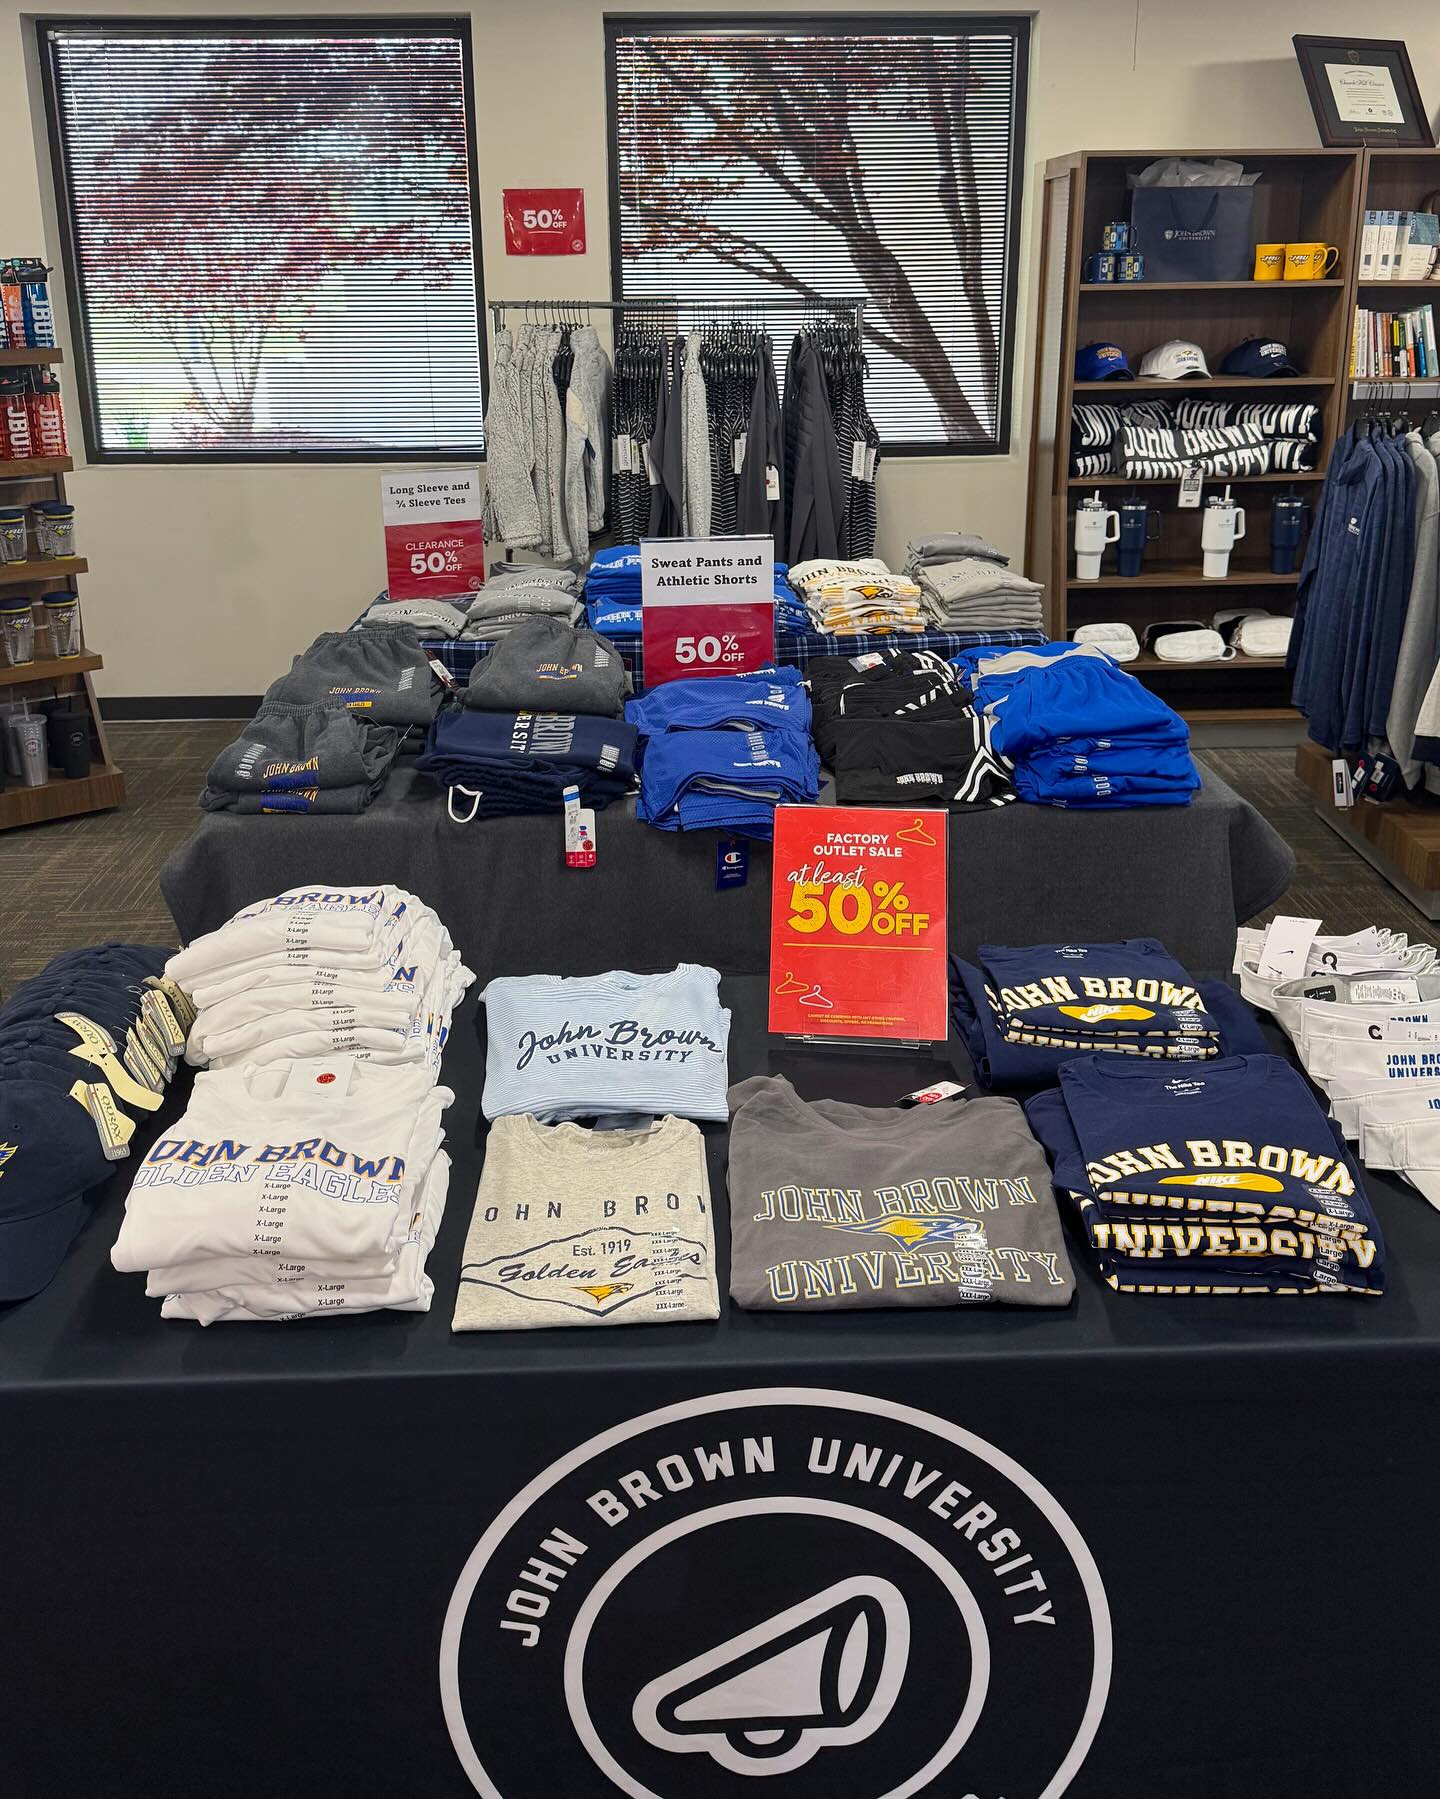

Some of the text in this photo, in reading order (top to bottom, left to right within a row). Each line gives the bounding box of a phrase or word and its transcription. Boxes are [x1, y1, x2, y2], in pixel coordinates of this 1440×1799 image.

[523, 209, 563, 228] 50%
[31, 294, 53, 335] JBU
[389, 482, 470, 496] Long Sleeve and
[409, 498, 440, 508] Sleeve
[444, 497, 466, 505] Tees
[406, 540, 464, 551] CLEARANCE
[410, 550, 462, 574] 50% OFF
[652, 558, 692, 568] Sweat
[696, 556, 733, 568] Pants
[738, 556, 762, 566] and
[656, 574, 758, 586] Athletic Shorts
[675, 635, 744, 664] 50% OFF
[263, 756, 319, 778] JOHN BROWN
[826, 834, 889, 844] FACTORY
[813, 845, 902, 857] OUTLET SALE
[787, 861, 867, 890] at least
[787, 880, 929, 935] 50% OFF
[316, 971, 338, 979] XX-Large
[312, 988, 334, 996] XX-Large
[332, 1018, 355, 1026] XX-Large
[332, 1035, 355, 1043] XX-Large
[516, 1020, 722, 1070] John Brown
[546, 1044, 694, 1064] UNIVERSITY
[1386, 1054, 1416, 1065] JOHN
[1186, 1140, 1357, 1196] BROWN
[1196, 1175, 1240, 1186] NIKE
[753, 1176, 1038, 1223] JOHN BROWN
[259, 1206, 286, 1214] X-Large
[256, 1220, 284, 1228] X-Large
[1330, 1222, 1354, 1230] X-Large
[254, 1234, 282, 1243] X-Large
[572, 1239, 631, 1256] Est. 1919
[1321, 1248, 1342, 1257] Large
[278, 1264, 305, 1272] X-Large
[1317, 1259, 1339, 1270] Large
[498, 1262, 598, 1282] Golden
[766, 1248, 1065, 1302] UNIVERITY
[1314, 1272, 1336, 1283] Large
[318, 1298, 344, 1306] X-Large
[500, 1436, 1056, 1648] JOHN BROWN UNIVERSITY
